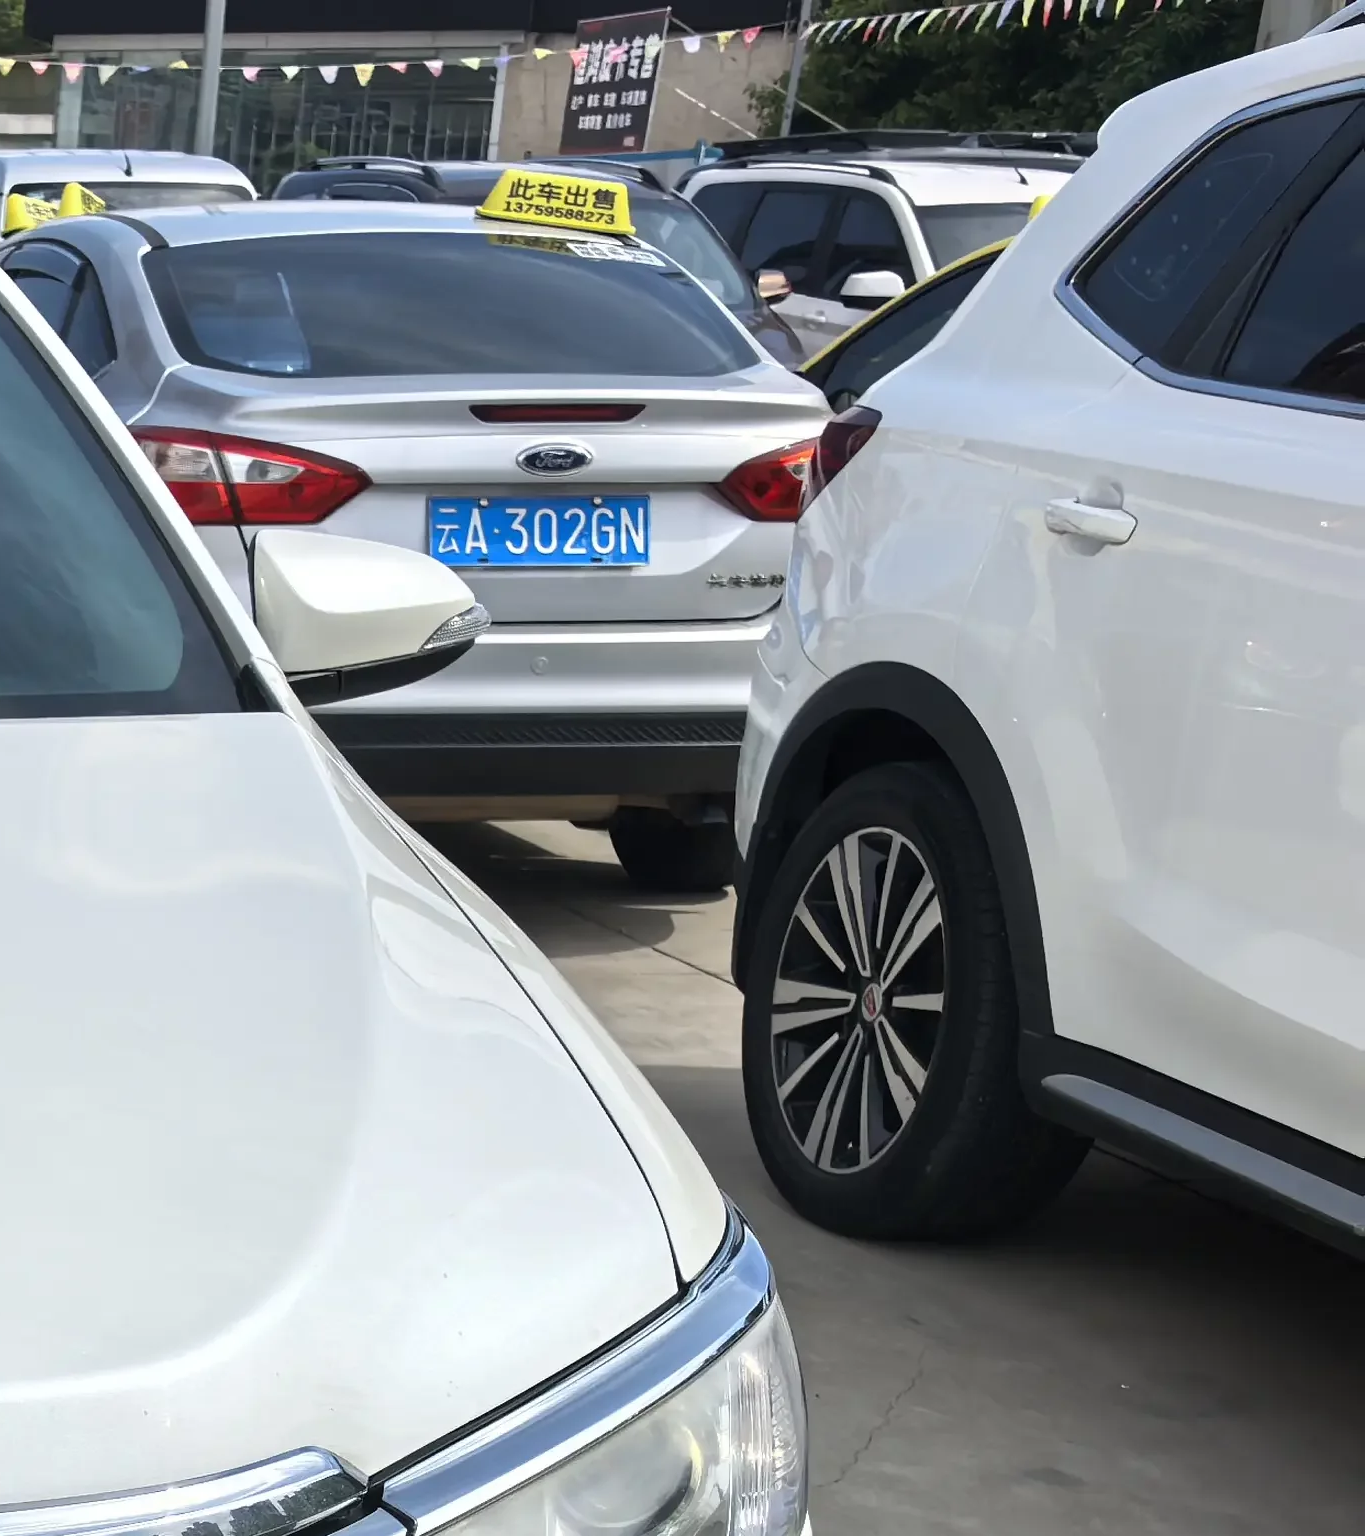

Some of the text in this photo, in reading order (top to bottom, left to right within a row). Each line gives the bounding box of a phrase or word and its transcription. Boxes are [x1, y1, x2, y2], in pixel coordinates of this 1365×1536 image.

[507, 177, 618, 211] 此车出售
[503, 201, 615, 225] 13759588273
[535, 450, 575, 468] Ford
